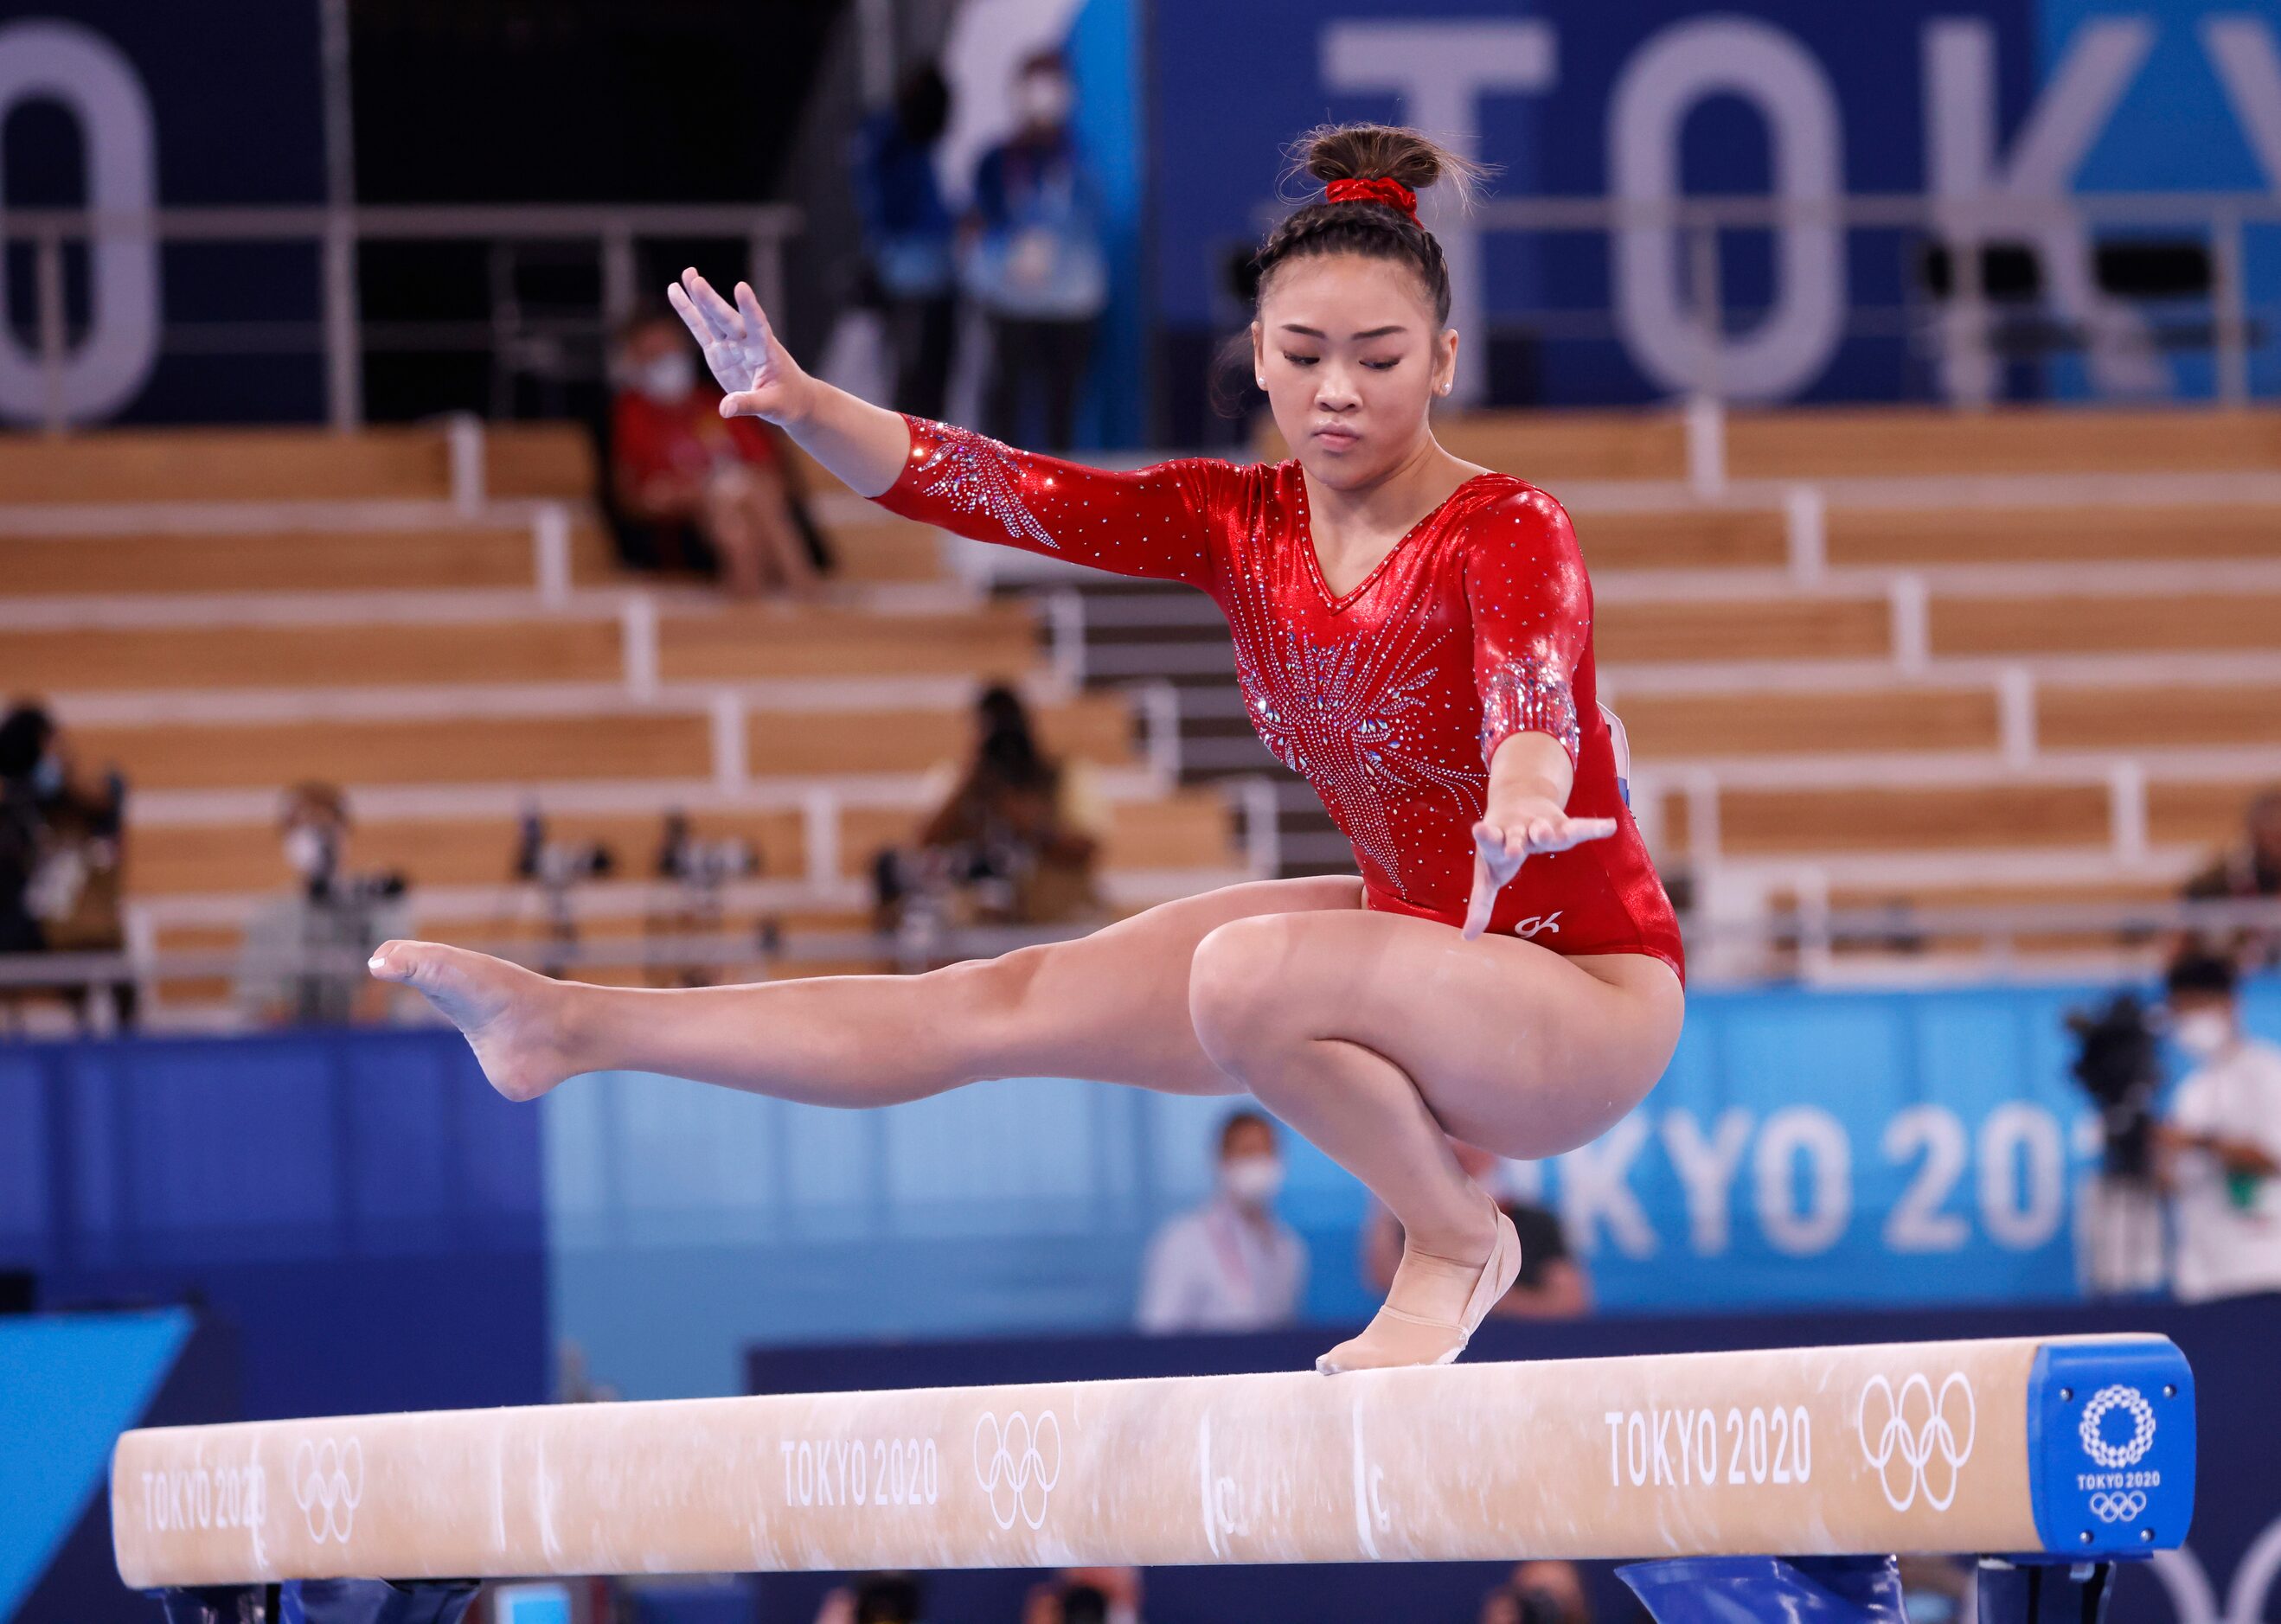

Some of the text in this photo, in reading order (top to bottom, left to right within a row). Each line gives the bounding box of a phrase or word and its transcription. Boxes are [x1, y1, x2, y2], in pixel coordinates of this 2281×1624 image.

[780, 1437, 939, 1506] TOKYO 2020
[1605, 1404, 1811, 1487] TOKYO 2020
[142, 1468, 212, 1532] TOKYO
[2077, 1470, 2161, 1491] TOKYO 2020
